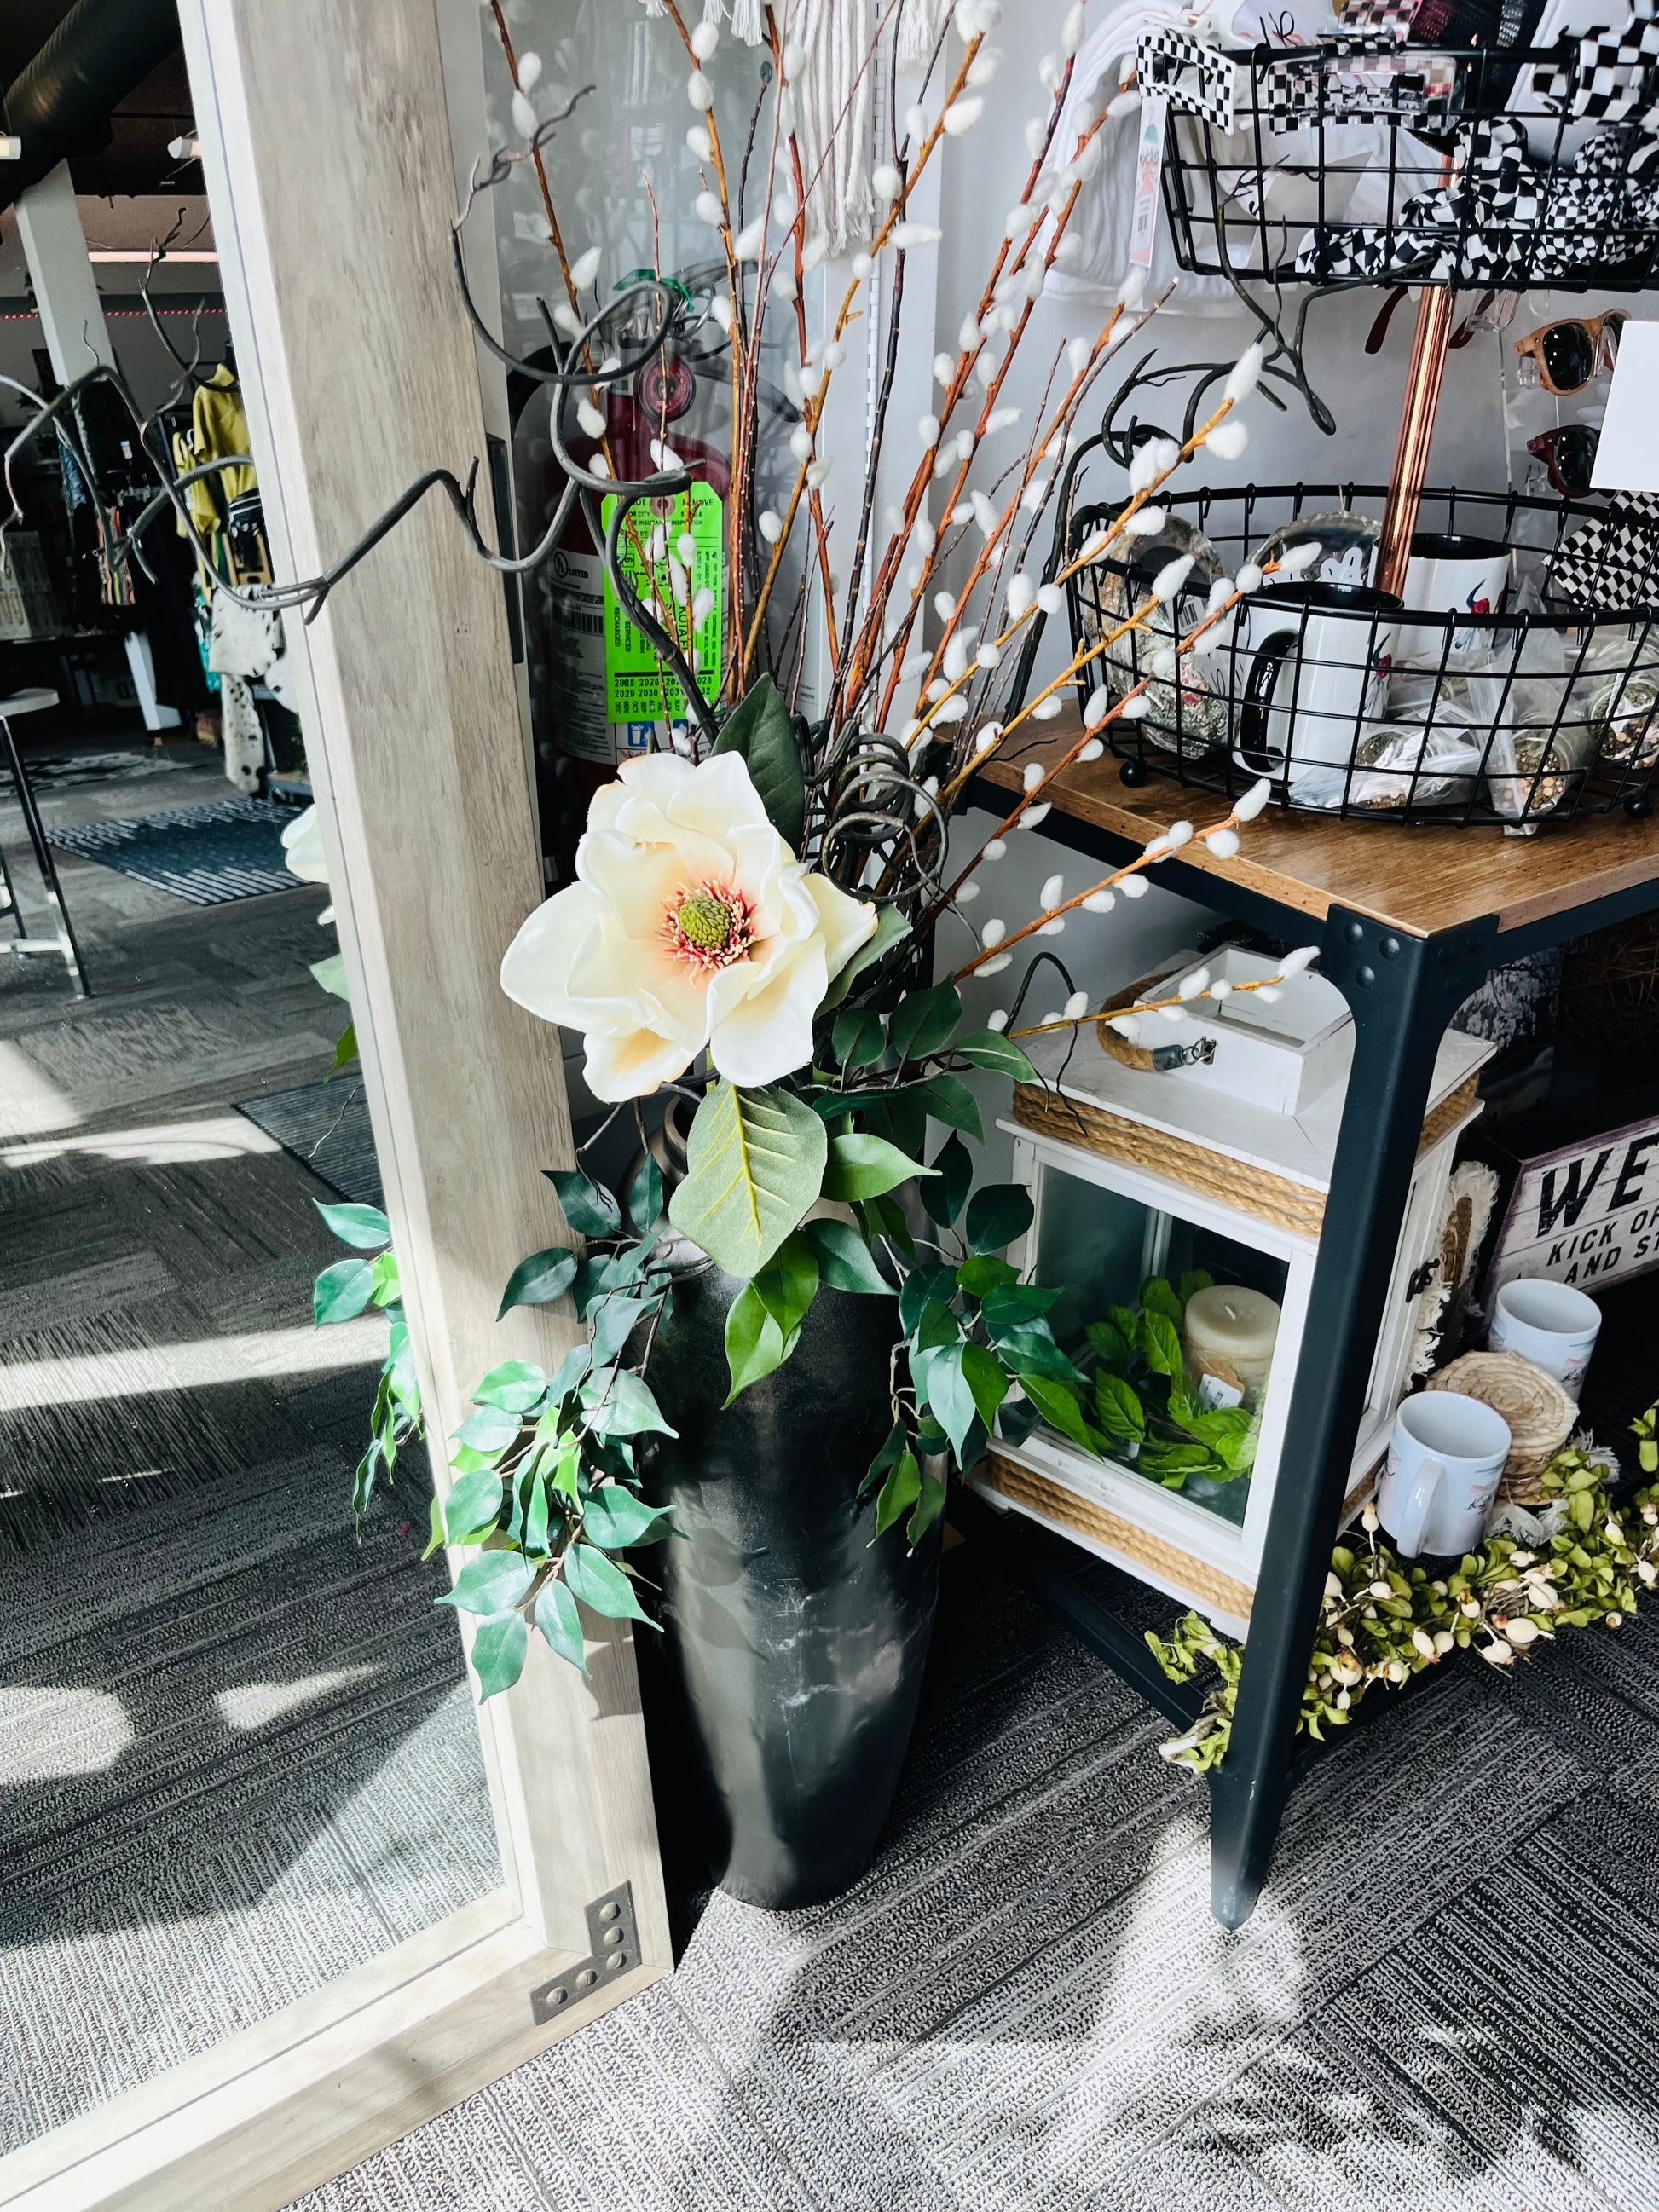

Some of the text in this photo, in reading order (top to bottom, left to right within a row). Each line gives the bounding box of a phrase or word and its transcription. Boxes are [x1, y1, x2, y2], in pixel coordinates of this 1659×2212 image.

[569, 567, 589, 579] LISTED
[679, 606, 687, 638] KOTA
[614, 679, 635, 687] 2025
[639, 678, 659, 686] 2026
[614, 690, 635, 698] 2029
[638, 689, 658, 697] 2030
[1546, 1221, 1619, 1268] KICK
[1564, 1246, 1621, 1284] AND
